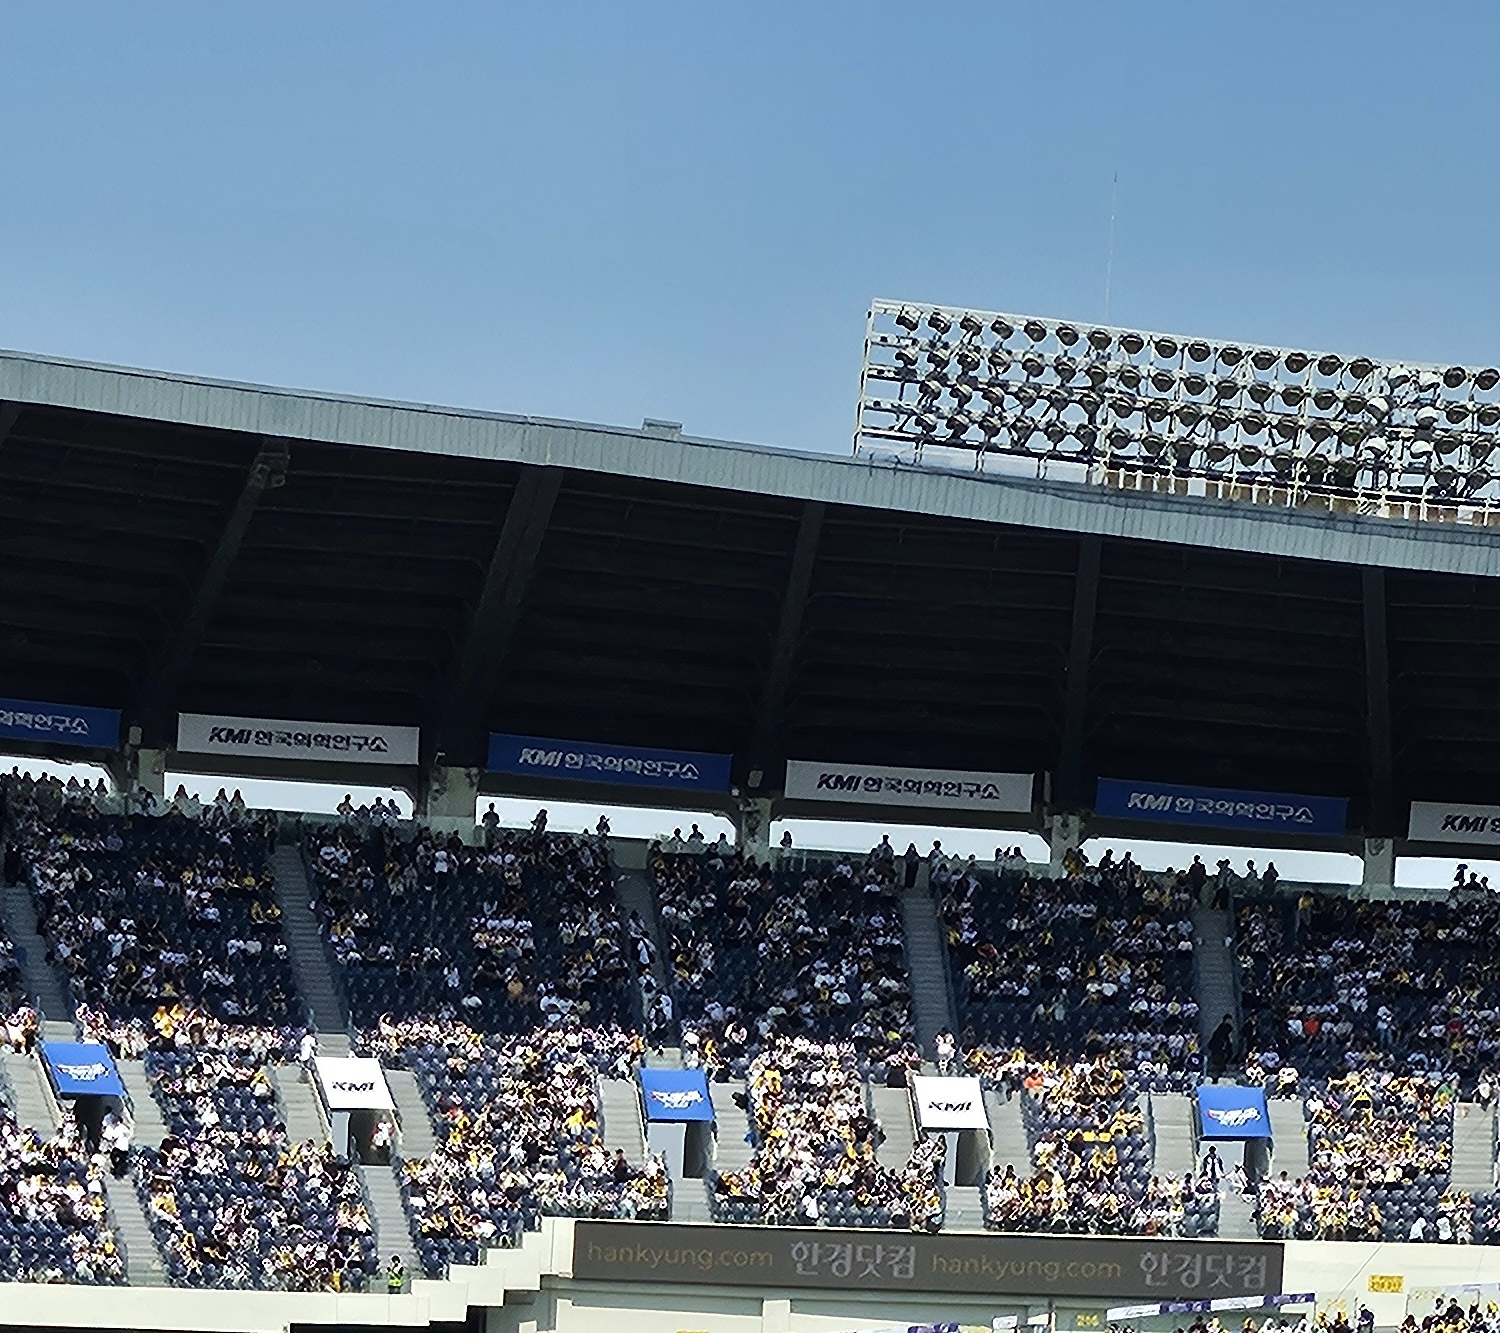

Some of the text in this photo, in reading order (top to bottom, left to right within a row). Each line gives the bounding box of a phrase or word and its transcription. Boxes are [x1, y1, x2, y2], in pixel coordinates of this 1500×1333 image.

[208, 726, 252, 744] KMI
[518, 748, 563, 767] KMI
[817, 773, 861, 792] KMI
[1128, 792, 1172, 812] KMI
[1441, 815, 1489, 832] KMI
[587, 1241, 1267, 1289] hankyung.com 한경닷컴 hankyung.com 한경닷컴
